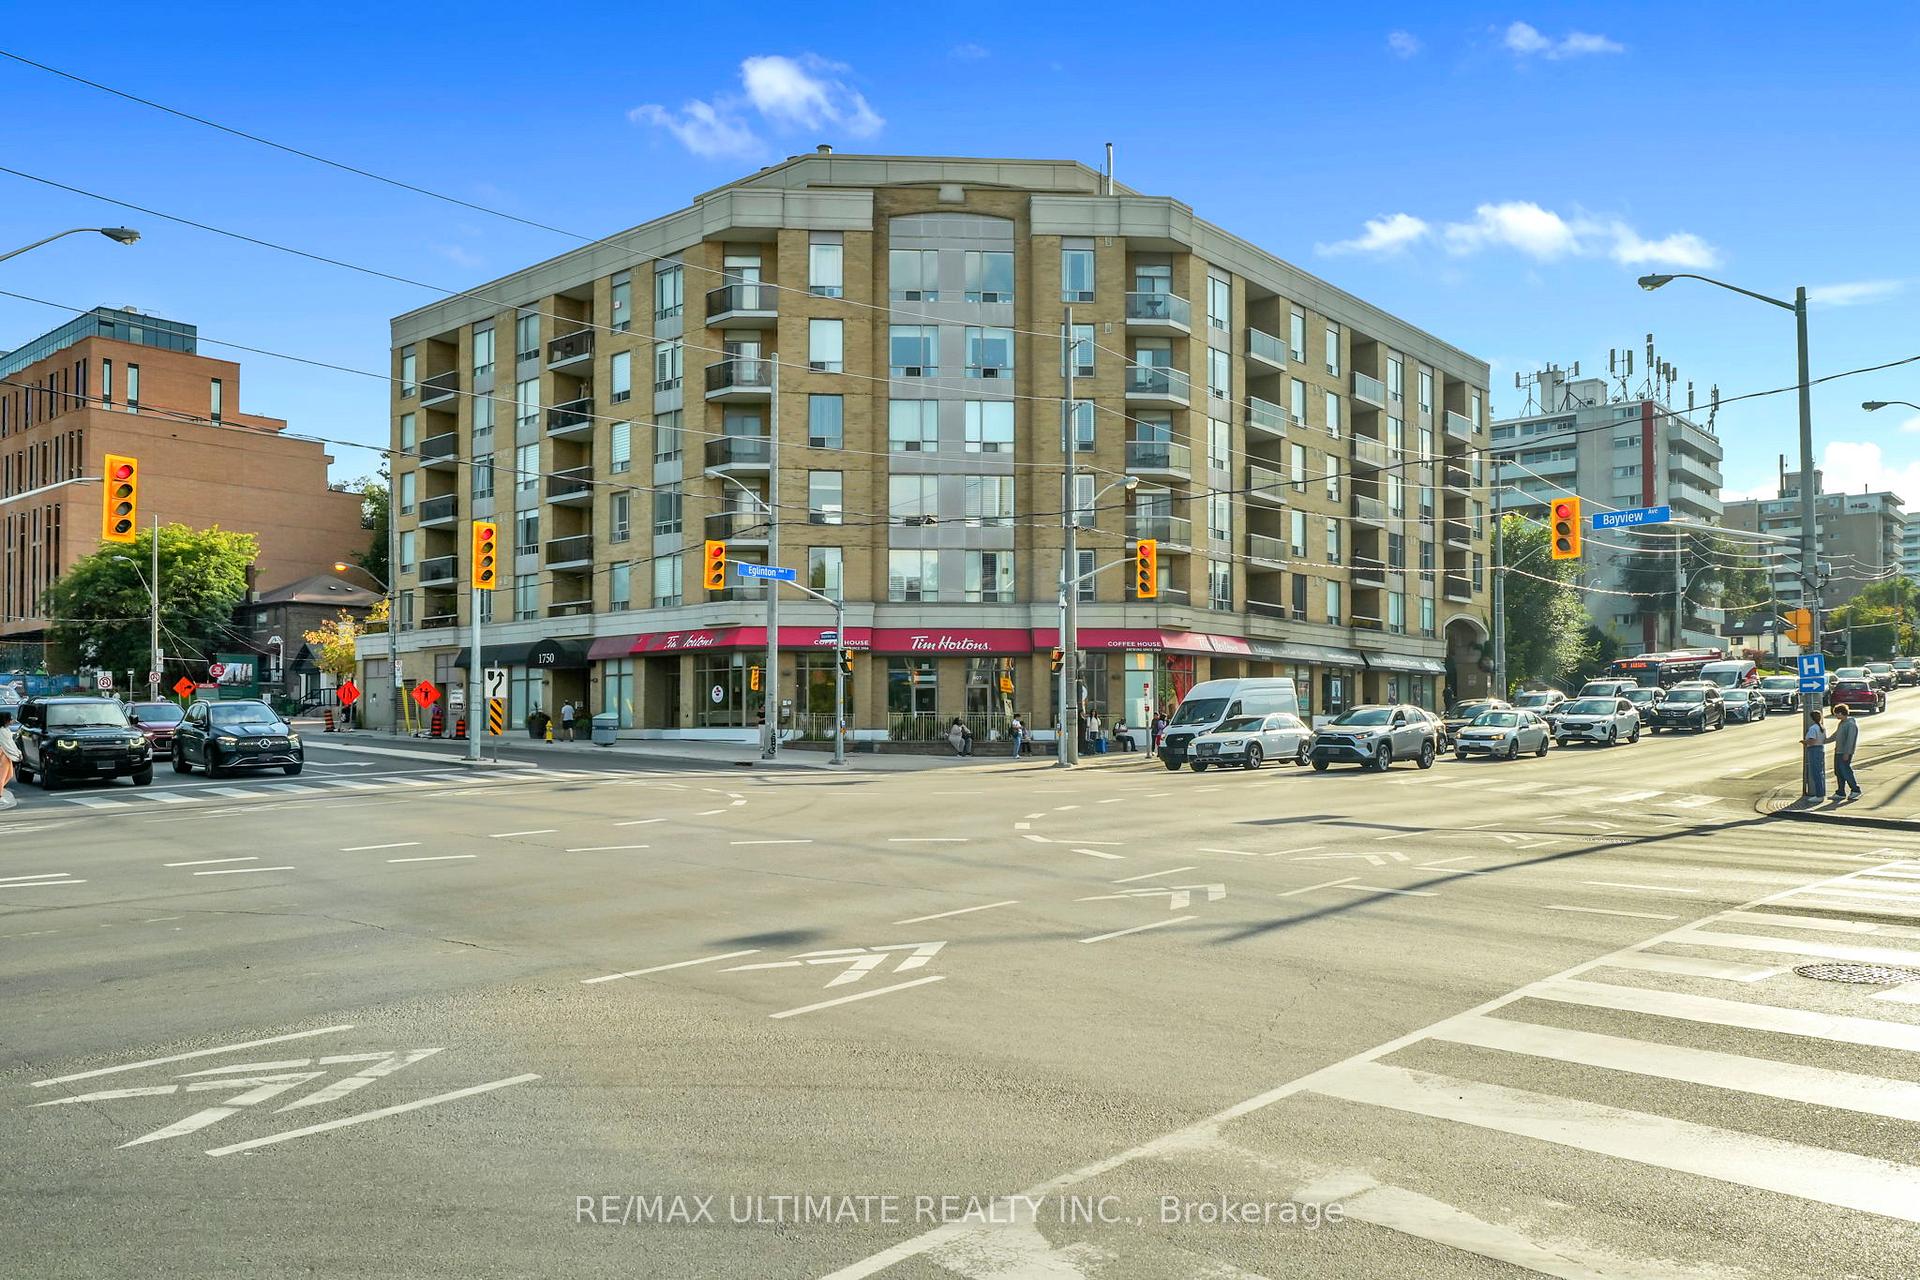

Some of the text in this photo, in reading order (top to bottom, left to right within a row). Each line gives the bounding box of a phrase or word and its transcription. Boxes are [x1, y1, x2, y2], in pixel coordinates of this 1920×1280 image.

[1603, 511, 1643, 526] Bayview
[748, 566, 776, 577] Eglinton
[911, 635, 936, 650] Tim
[538, 653, 555, 663] 1750
[1803, 656, 1820, 675] H
